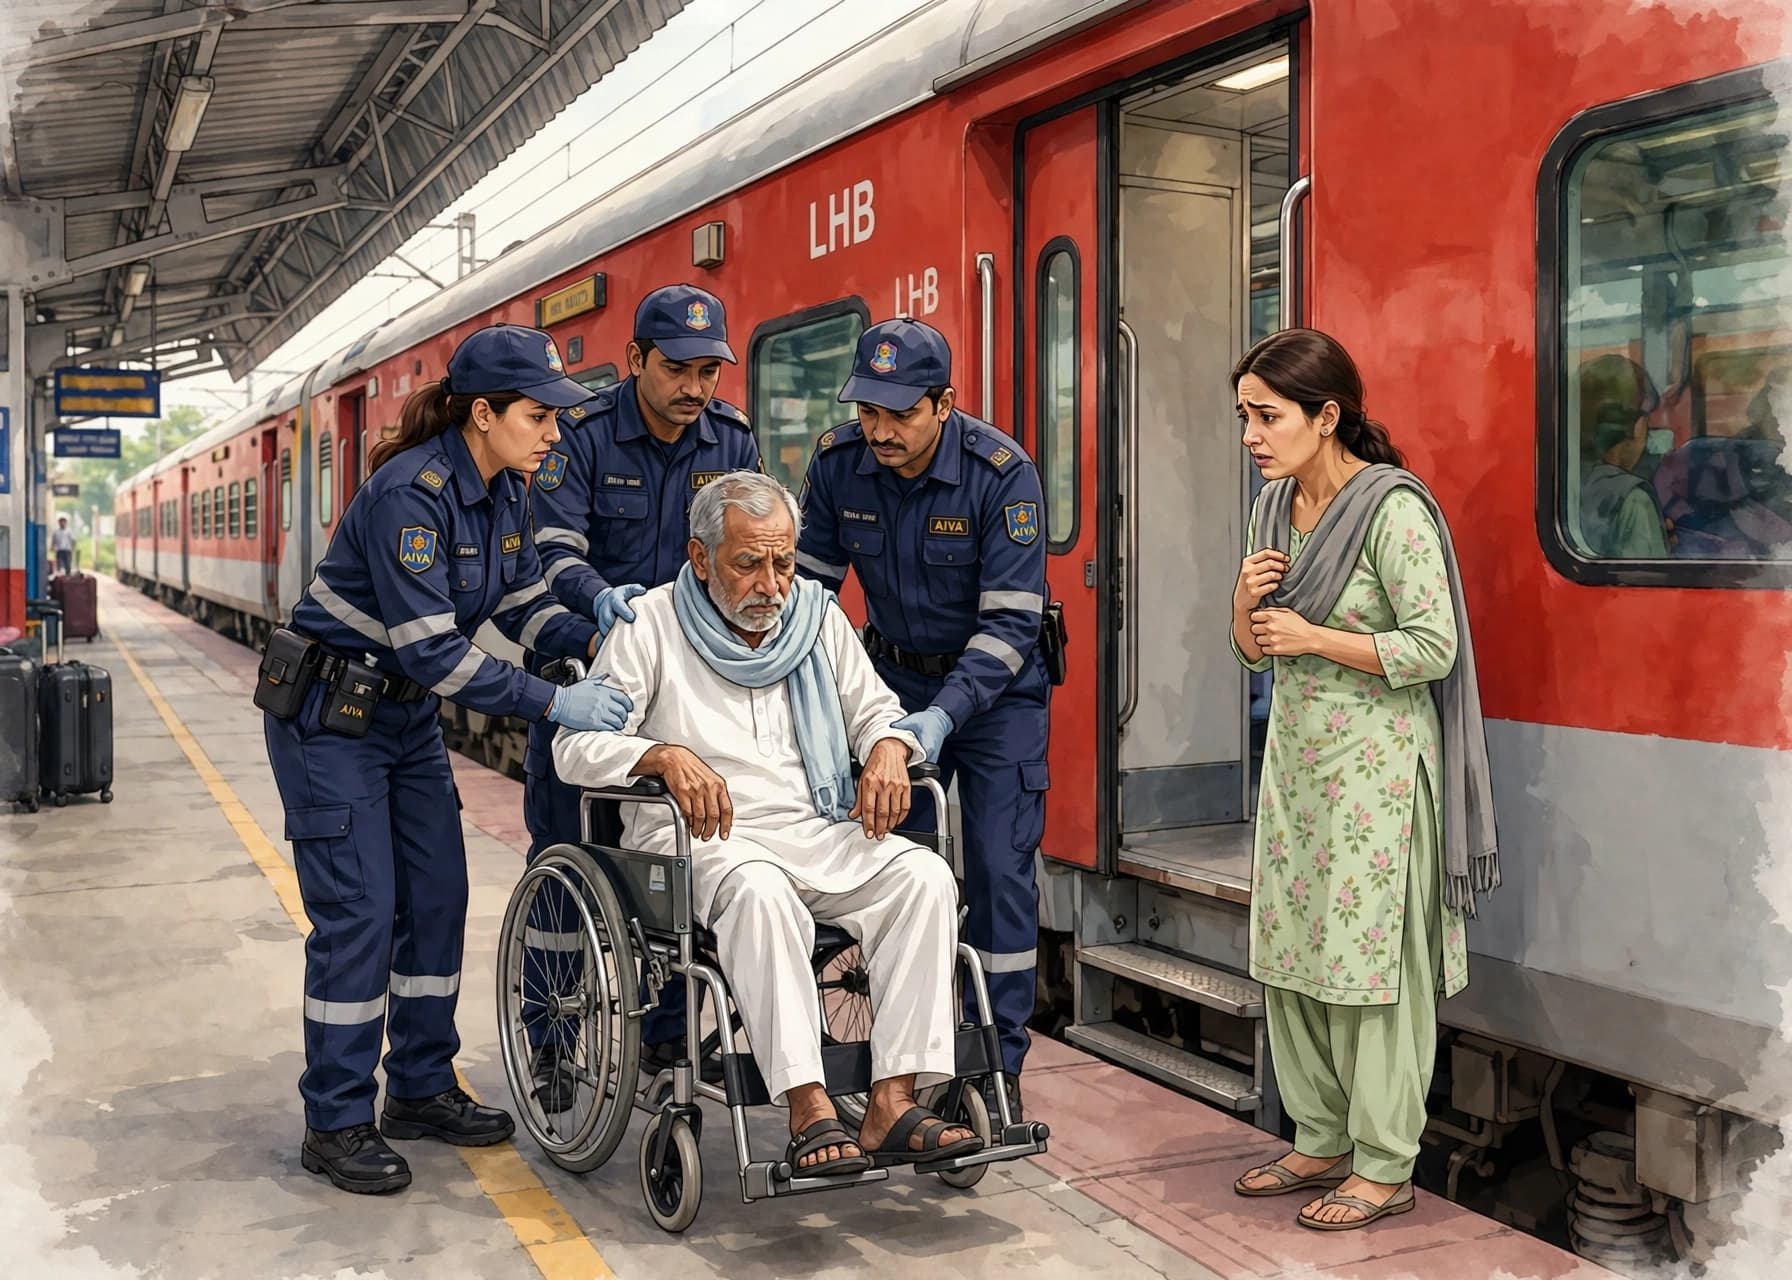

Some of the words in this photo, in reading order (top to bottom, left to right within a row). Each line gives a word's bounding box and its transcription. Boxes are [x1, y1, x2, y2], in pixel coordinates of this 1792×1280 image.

[810, 179, 875, 260] LHB
[895, 266, 939, 319] LHB
[935, 520, 963, 532] AIVA
[1012, 526, 1036, 537] AIVA
[403, 552, 430, 564] AIVA
[340, 704, 363, 719] AIVA
